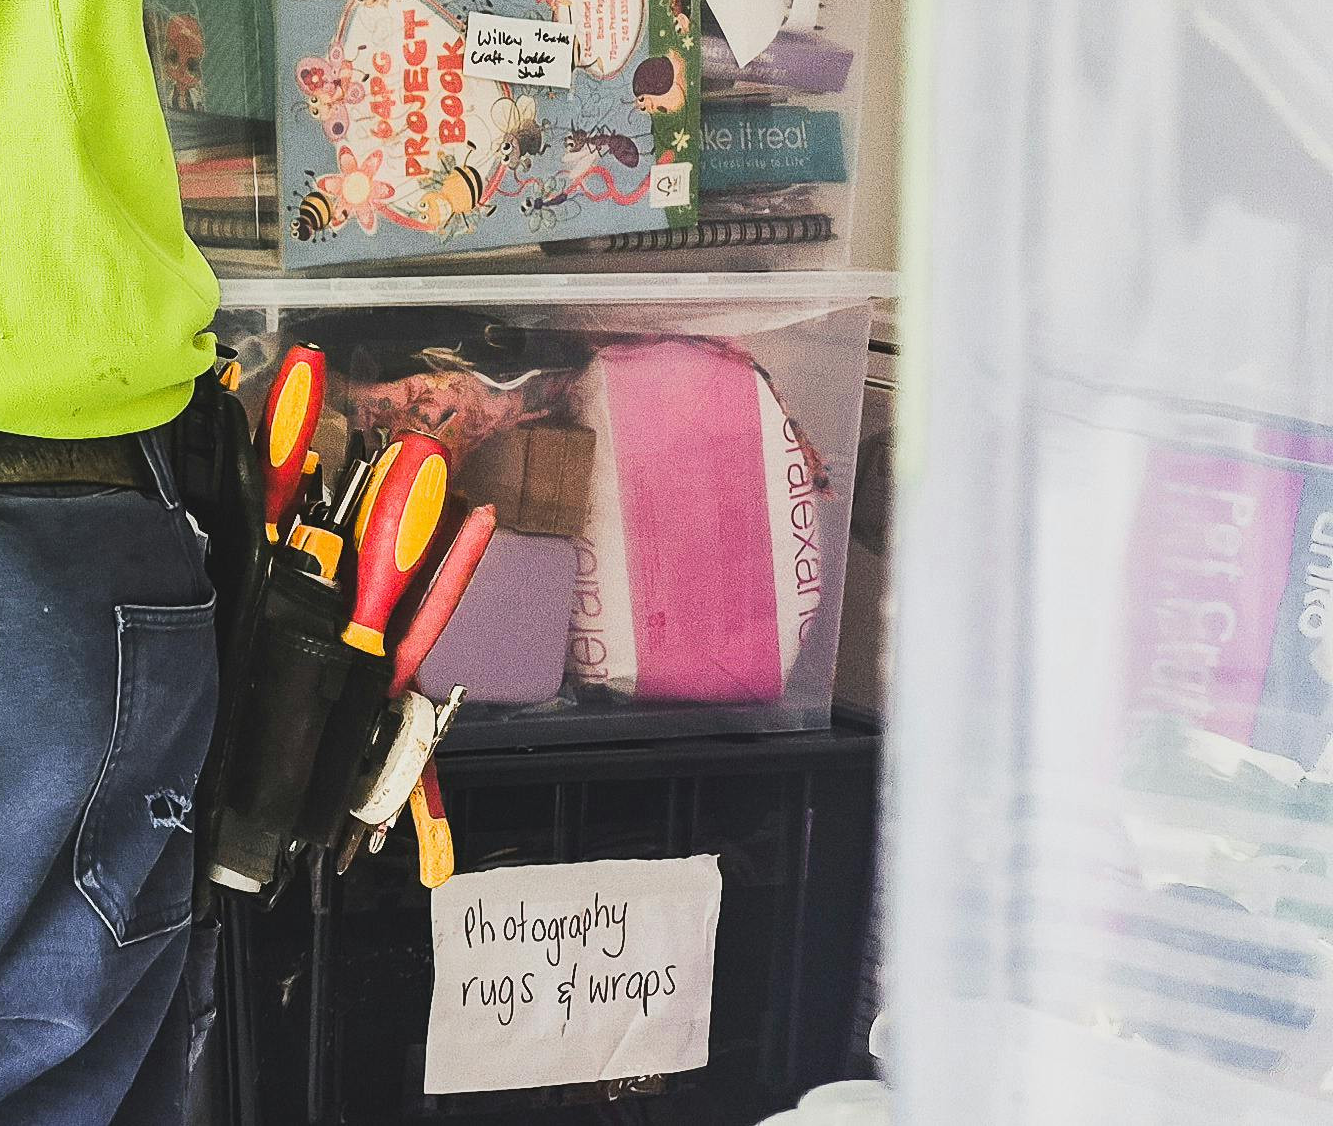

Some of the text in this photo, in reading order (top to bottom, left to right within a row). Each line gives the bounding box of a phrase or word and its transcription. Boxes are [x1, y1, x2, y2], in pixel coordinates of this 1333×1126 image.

[369, 51, 396, 140] 64PG
[402, 9, 431, 177] PROJECT
[437, 36, 467, 145] BOOK
[700, 121, 809, 151] ke it real
[464, 892, 627, 966] Photography
[462, 963, 677, 1026] rugs & wraps
